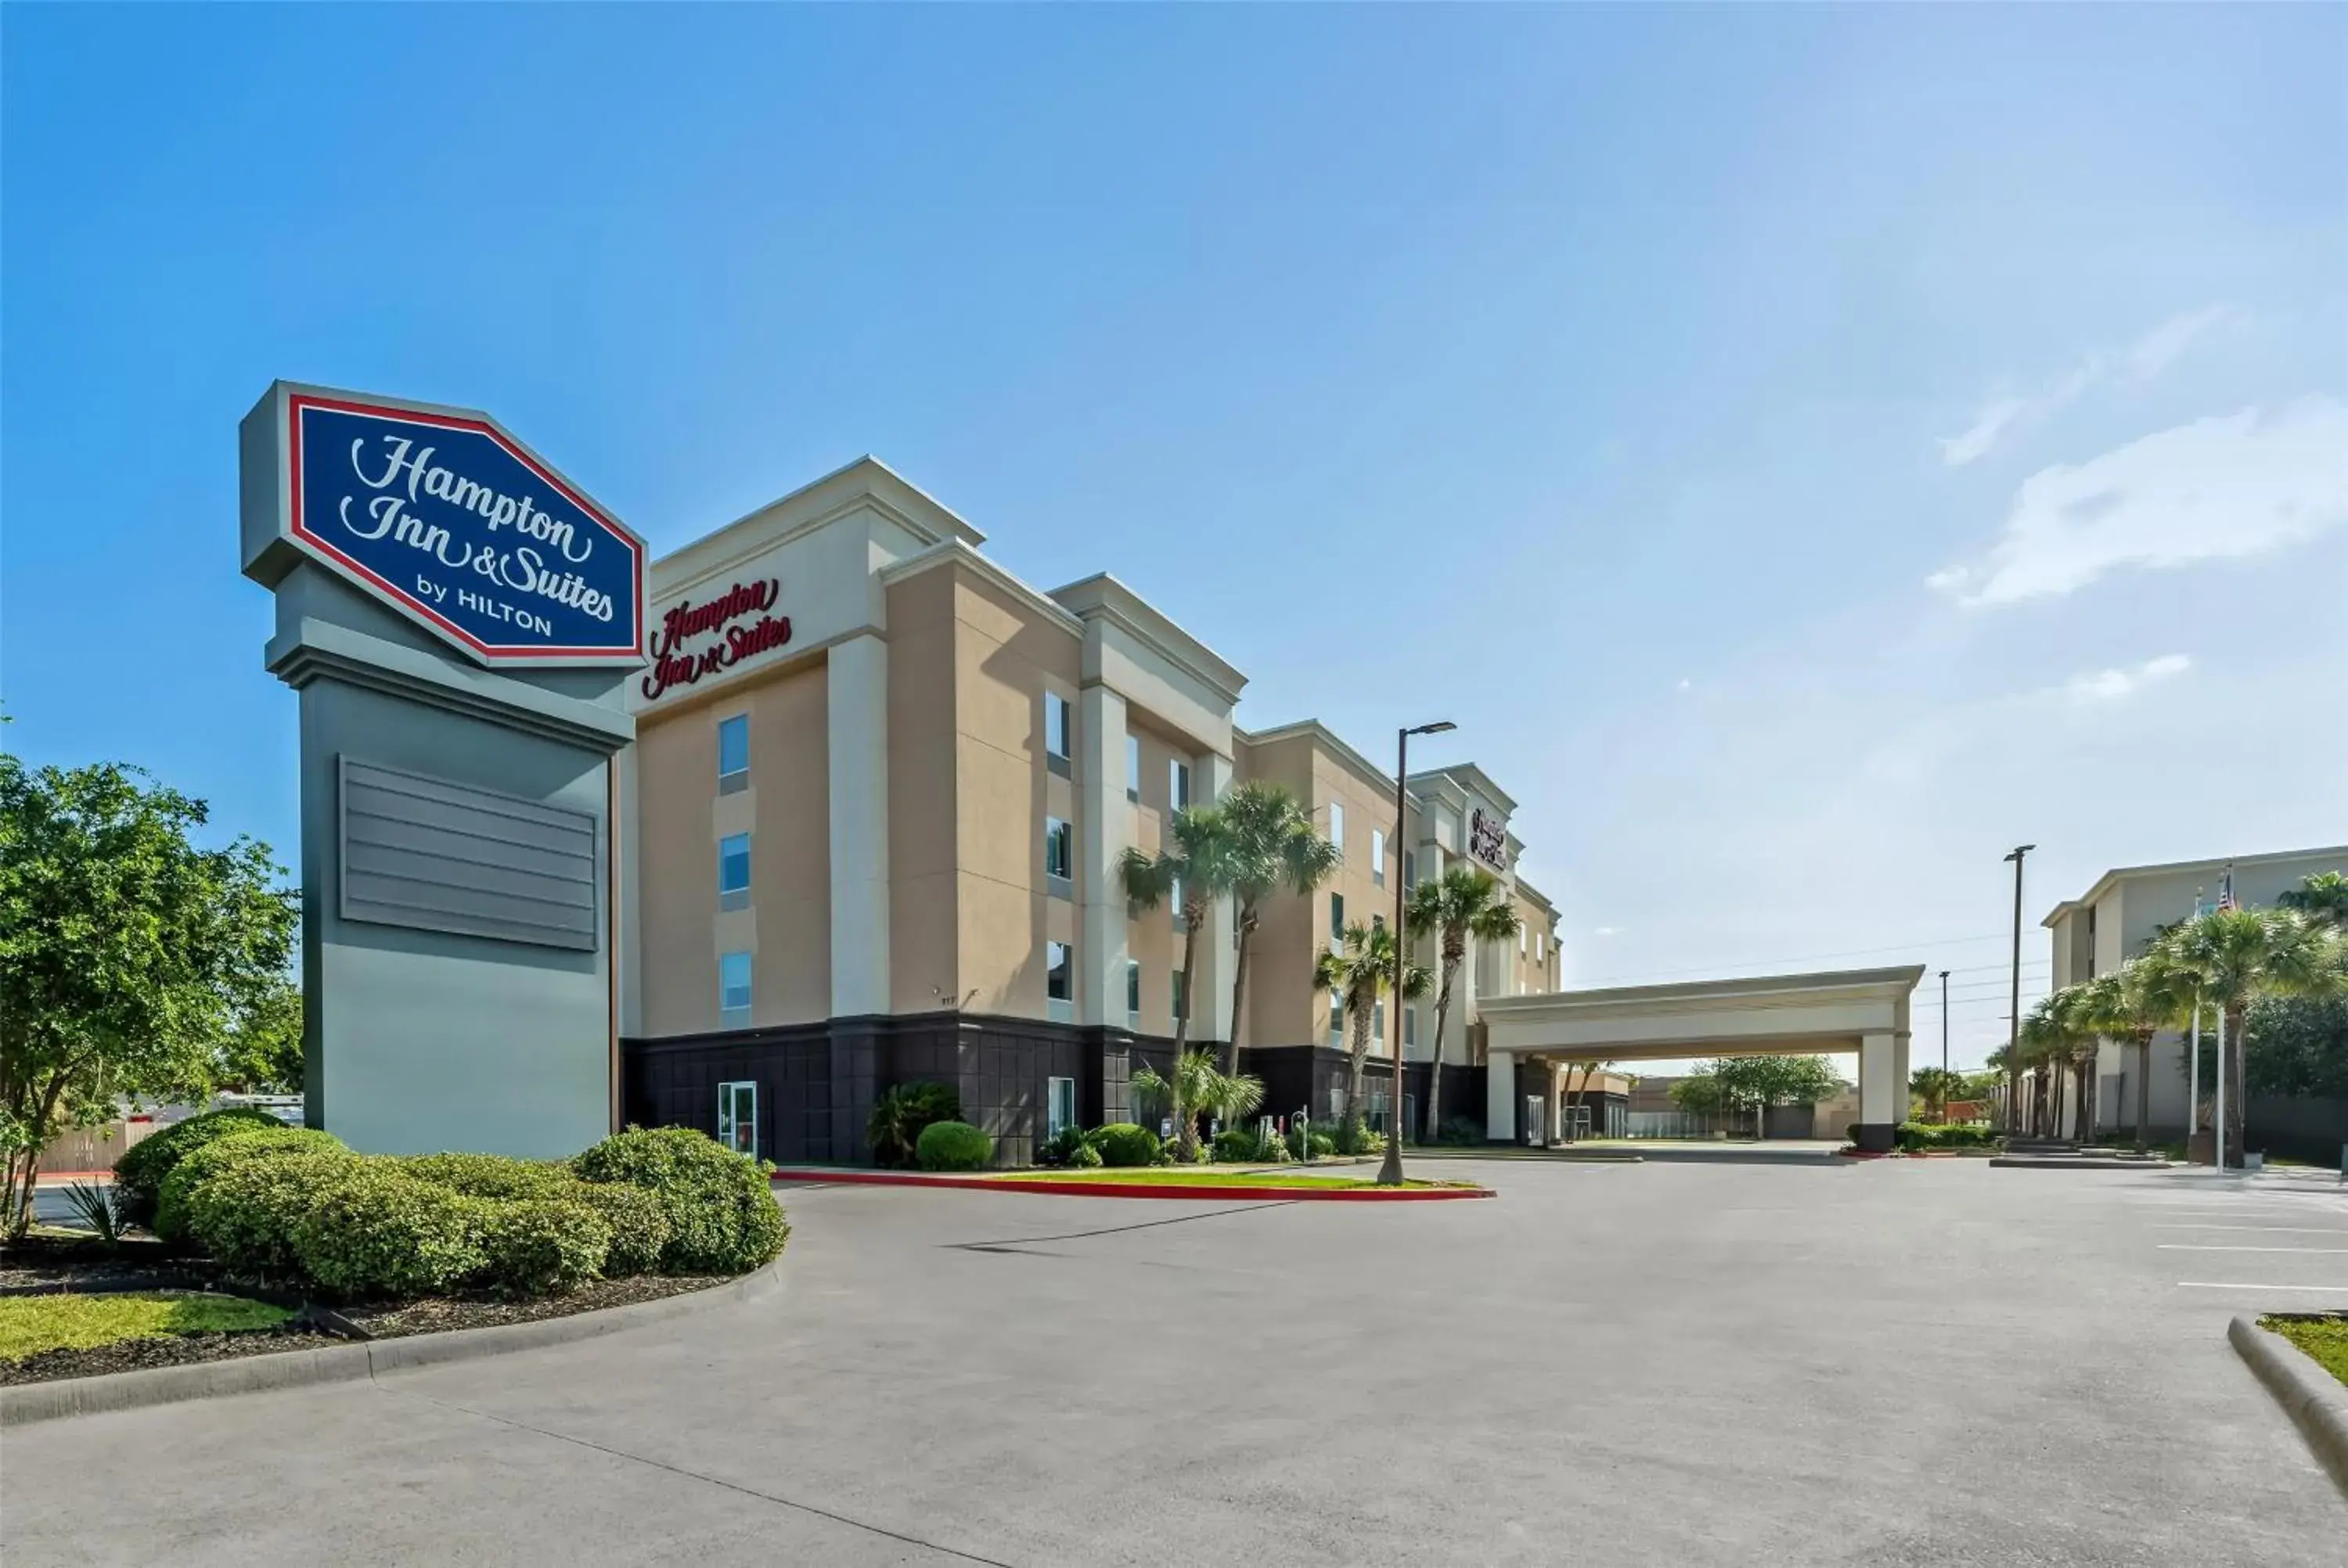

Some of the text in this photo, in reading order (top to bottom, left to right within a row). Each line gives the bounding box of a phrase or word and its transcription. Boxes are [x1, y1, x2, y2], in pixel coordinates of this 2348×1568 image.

[351, 435, 592, 563] Hampton
[340, 495, 472, 567] Inn
[500, 548, 614, 622] Suites
[416, 574, 551, 637] by HILTON
[650, 578, 779, 659] Hampton
[642, 654, 702, 699] Inn
